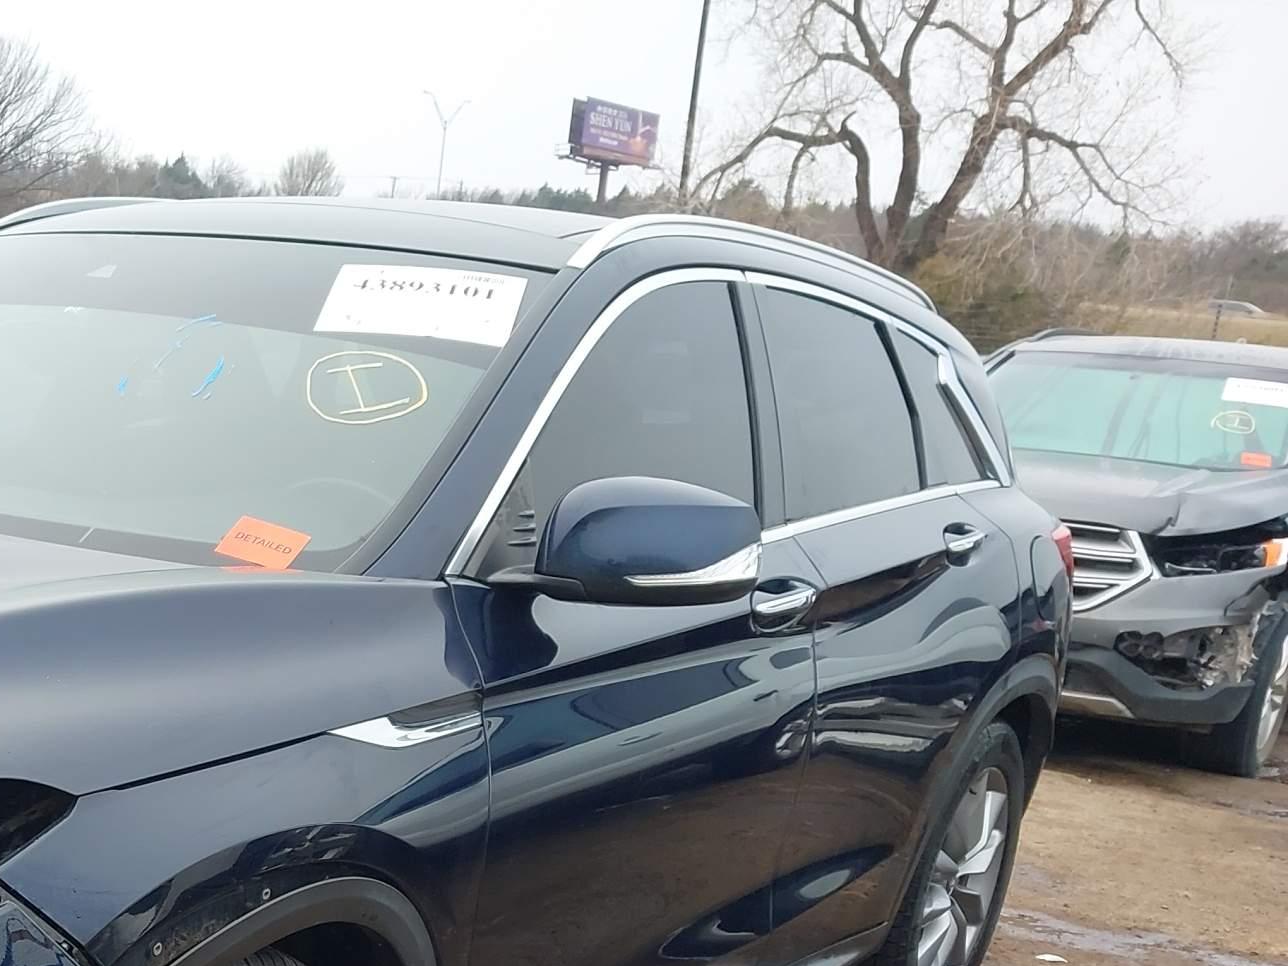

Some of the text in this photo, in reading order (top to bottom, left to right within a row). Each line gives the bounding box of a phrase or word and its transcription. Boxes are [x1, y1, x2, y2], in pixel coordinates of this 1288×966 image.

[590, 111, 612, 128] SHEN
[353, 278, 494, 300] 43893101
[234, 531, 292, 555] DETAILED
